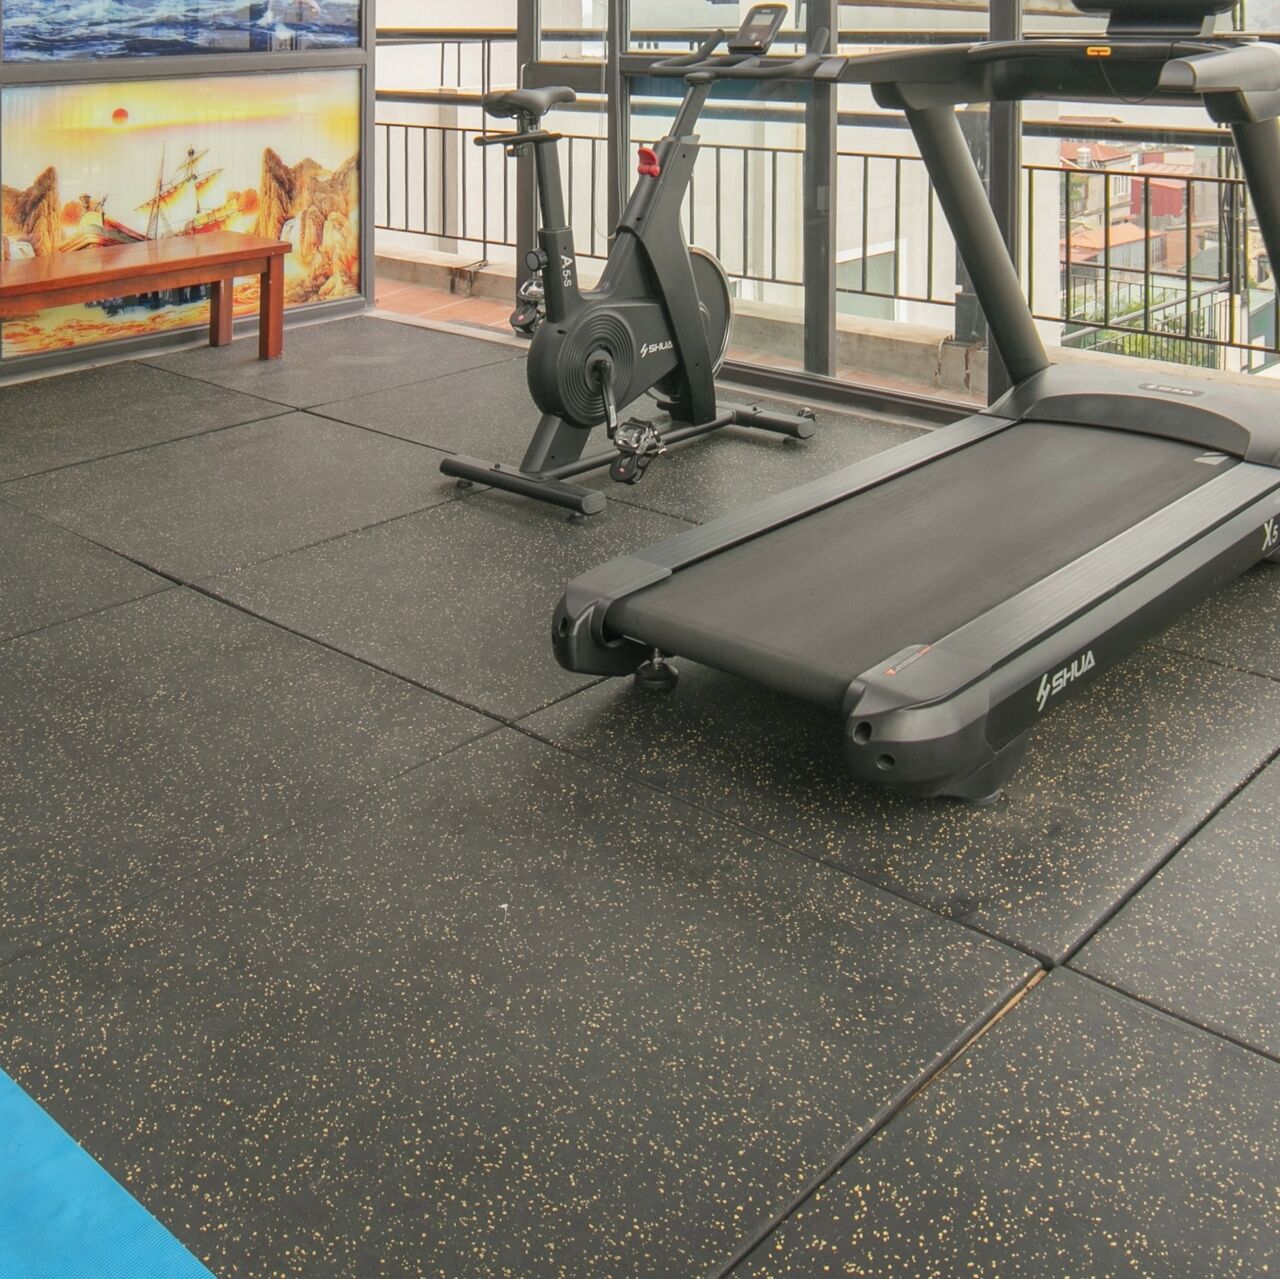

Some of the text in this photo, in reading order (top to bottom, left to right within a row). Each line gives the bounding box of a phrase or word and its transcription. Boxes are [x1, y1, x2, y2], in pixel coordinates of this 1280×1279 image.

[648, 340, 673, 354] SHUA
[1261, 517, 1279, 552] X5
[1051, 649, 1096, 696] SHUA
